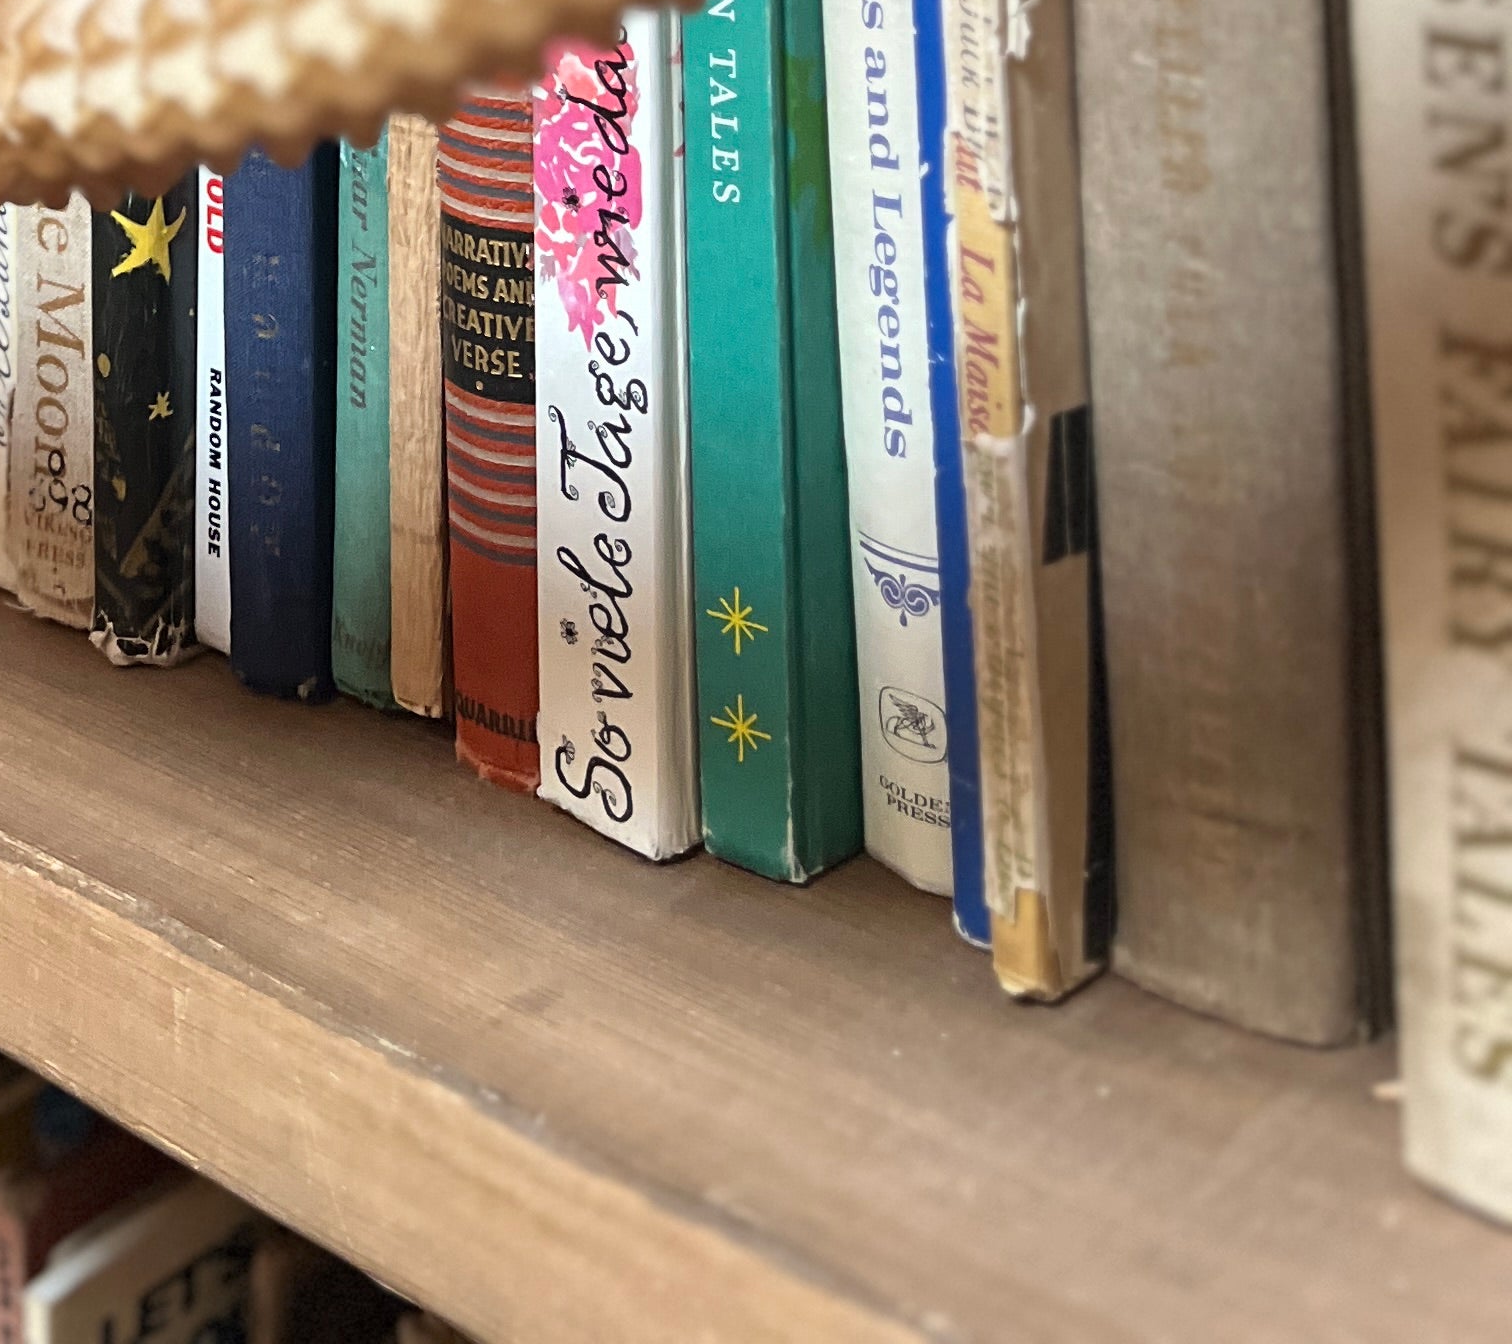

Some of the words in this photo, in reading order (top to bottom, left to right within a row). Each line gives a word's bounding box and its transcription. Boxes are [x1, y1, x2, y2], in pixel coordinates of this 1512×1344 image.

[710, 49, 741, 205] TALES
[864, 45, 902, 173] and
[441, 224, 534, 270] NARRATIV
[591, 165, 629, 300] wie
[960, 241, 995, 305] La
[34, 274, 84, 479] Moon
[350, 240, 379, 410] Nerman
[442, 295, 534, 343] CREATIVE
[452, 334, 523, 378] VERSE
[868, 190, 909, 459] Legends
[208, 367, 222, 470] RANDOM
[208, 478, 222, 559] HOUSE
[556, 533, 633, 704] viele
[887, 793, 951, 829] PRESS
